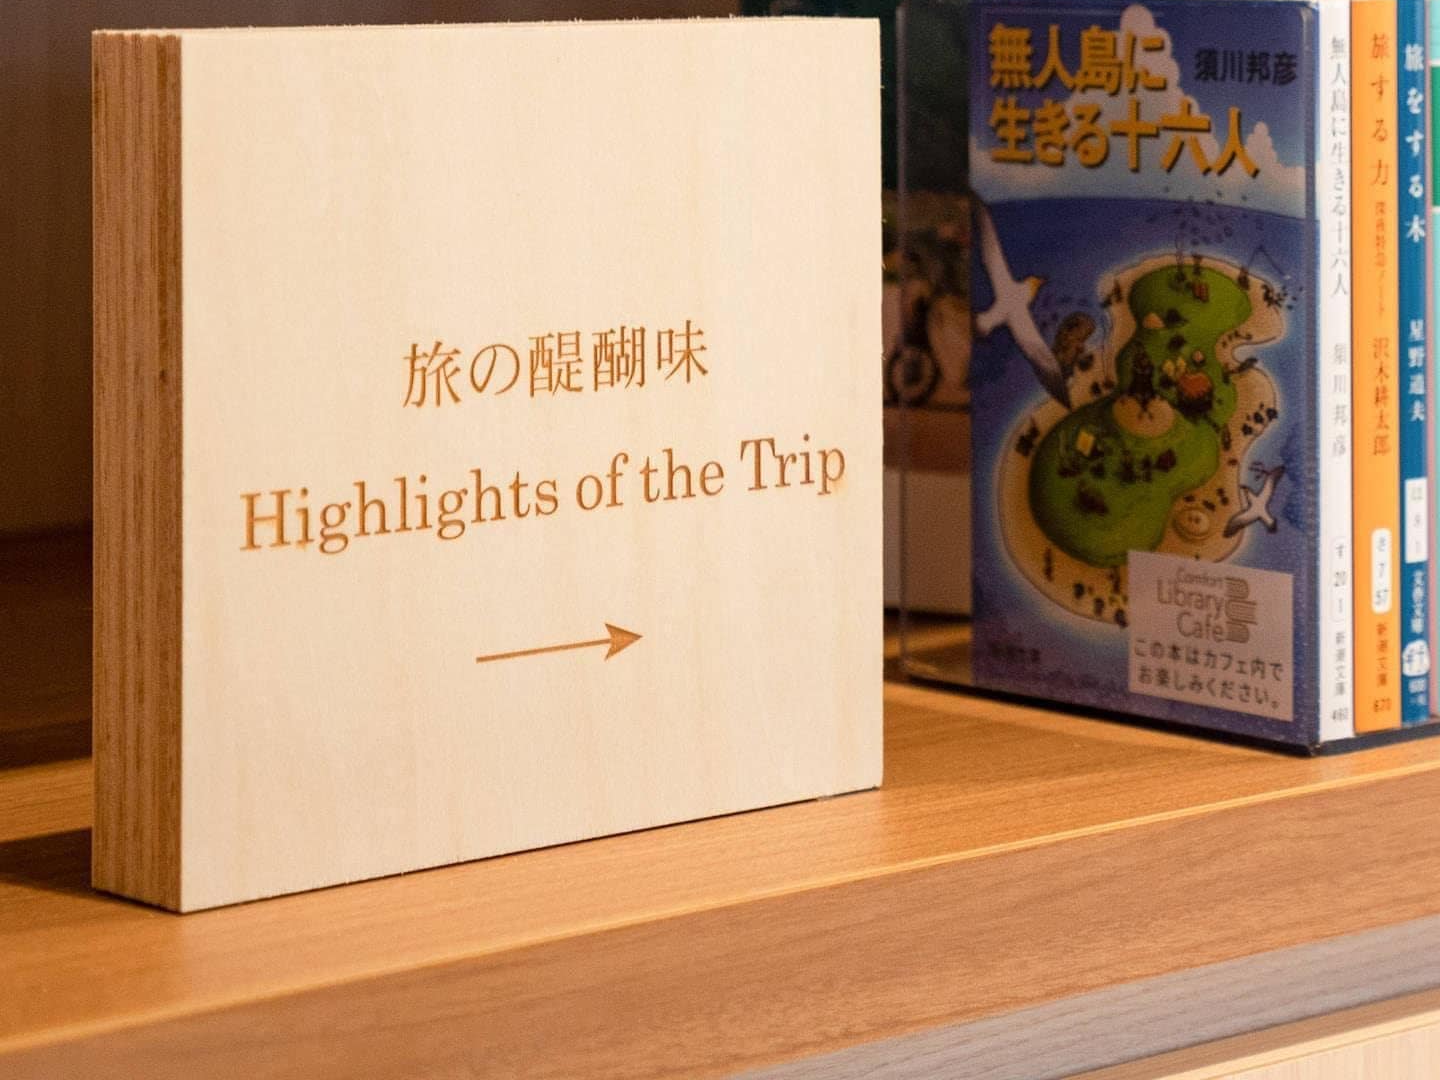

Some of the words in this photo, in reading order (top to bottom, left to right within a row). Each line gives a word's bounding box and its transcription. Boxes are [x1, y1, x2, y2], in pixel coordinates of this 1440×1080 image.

[988, 23, 1167, 96] 無人島に
[988, 95, 1260, 178] 生きる十六人
[1371, 32, 1391, 186] 旅する力
[1330, 36, 1348, 298] 無人島に生きる十六人
[402, 320, 709, 408] 旅の醍醐味
[238, 467, 558, 555] Highlights
[575, 452, 630, 511] of
[639, 447, 725, 503] the
[740, 433, 847, 497] Trip
[1157, 578, 1225, 620] Library
[1134, 638, 1284, 682] この本はカフェ内で
[1138, 665, 1279, 710] お楽しみください。
